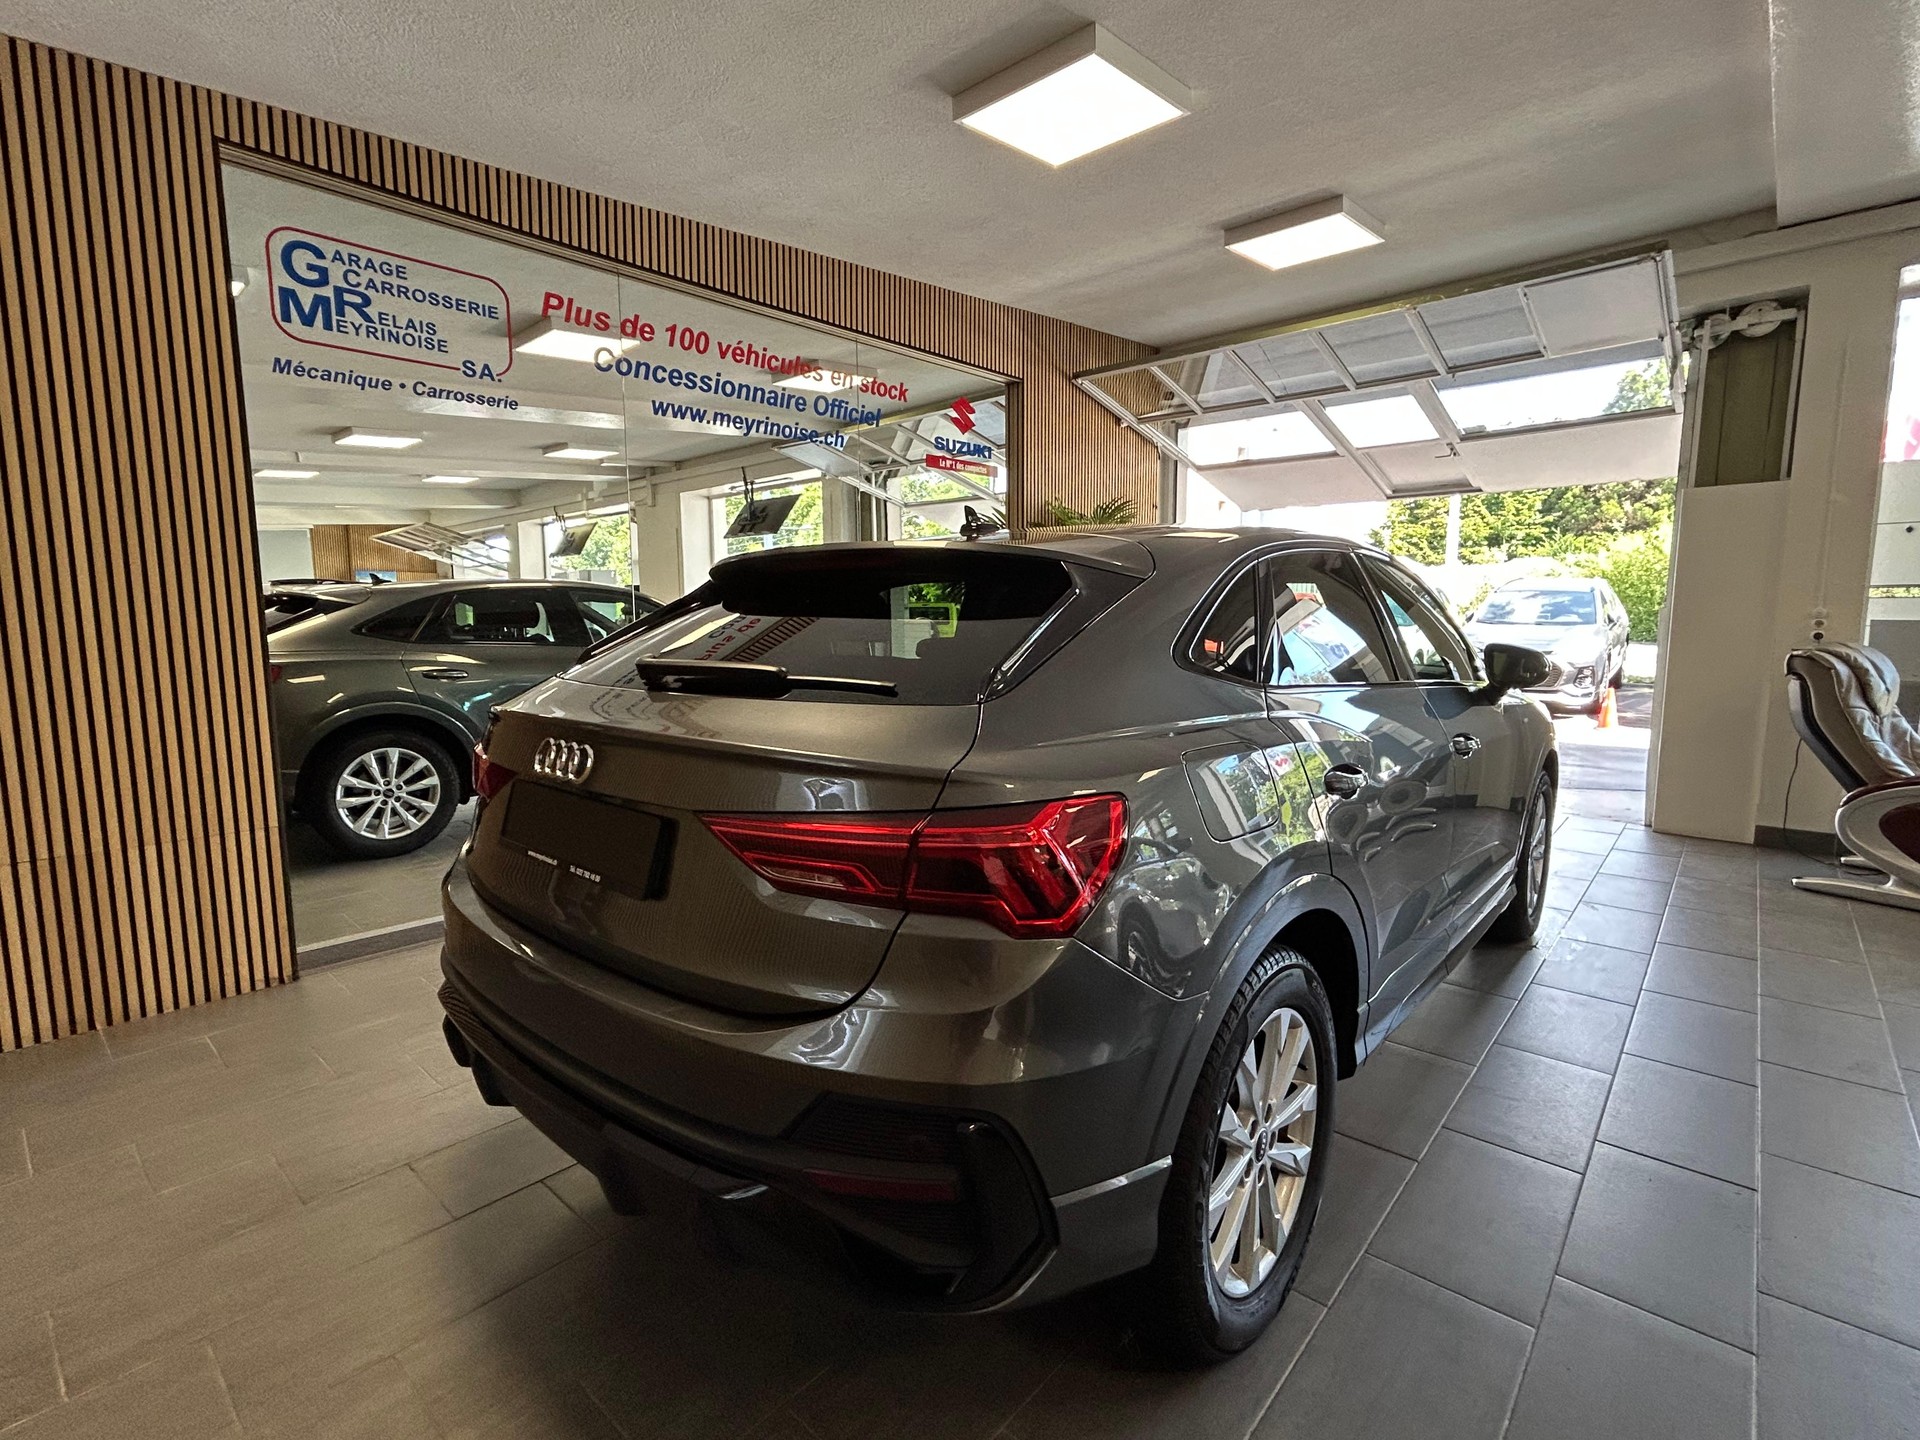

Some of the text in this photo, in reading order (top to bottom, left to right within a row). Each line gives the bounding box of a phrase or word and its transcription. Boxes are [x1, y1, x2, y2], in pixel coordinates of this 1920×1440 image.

[279, 239, 408, 289] GARAGE
[277, 286, 449, 354] MEYRINOISE
[332, 285, 438, 337] RELAIS
[342, 268, 499, 320] CARROSSERIE
[541, 291, 909, 403] Plus de 100 véhicules en stock
[271, 356, 519, 411] Mécanique Carrosserie
[593, 346, 882, 428] Concessionnaire Officiel
[651, 399, 845, 448] www.meyrinoise.ch
[933, 435, 993, 460] SUZUKI
